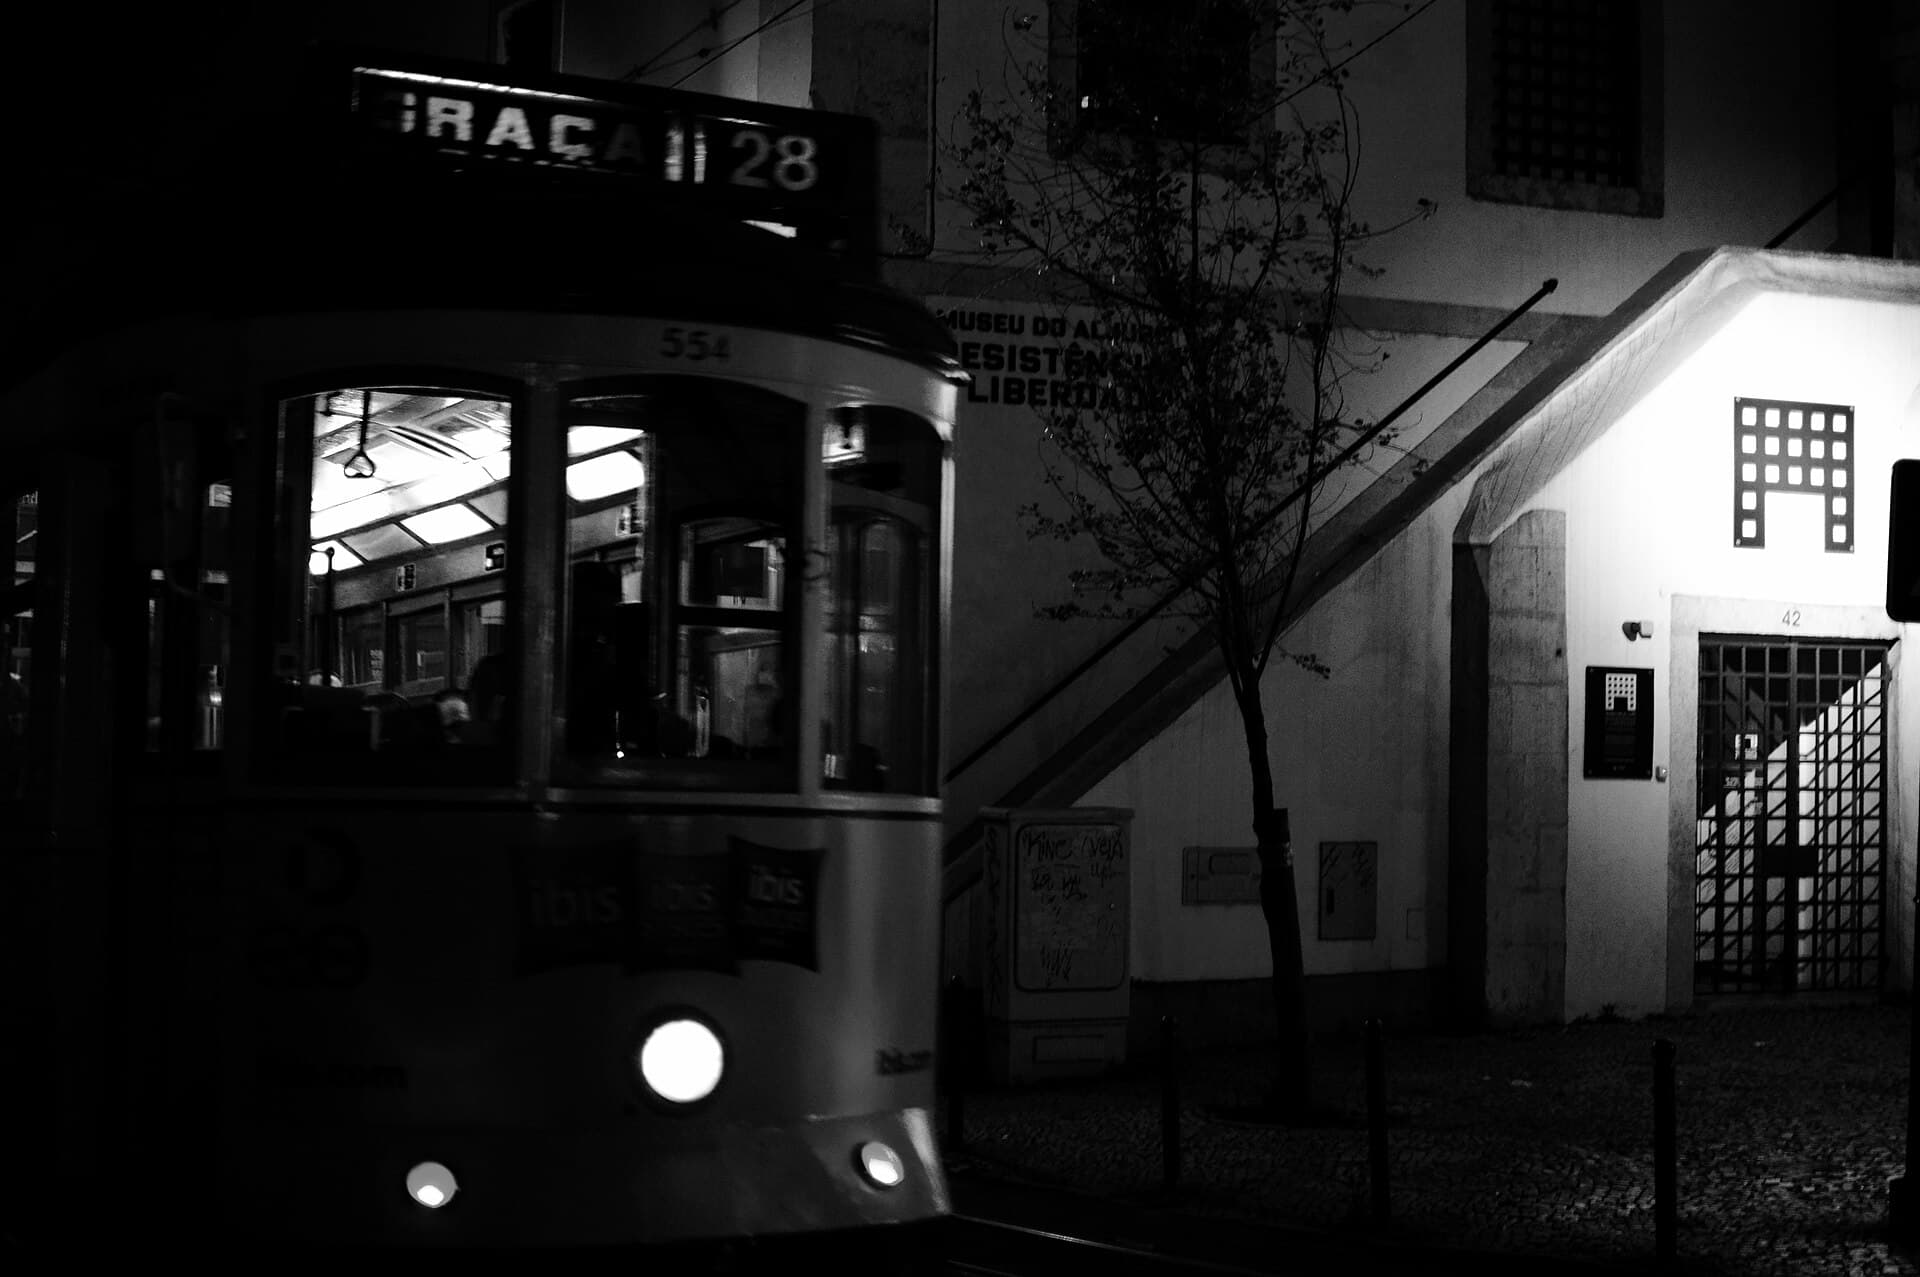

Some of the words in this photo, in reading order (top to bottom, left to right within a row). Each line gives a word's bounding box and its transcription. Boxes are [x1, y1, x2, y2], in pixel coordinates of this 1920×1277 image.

[728, 128, 819, 193] 28
[1032, 316, 1066, 337] DO
[1782, 609, 1801, 627] 42
[746, 863, 806, 905] ibis
